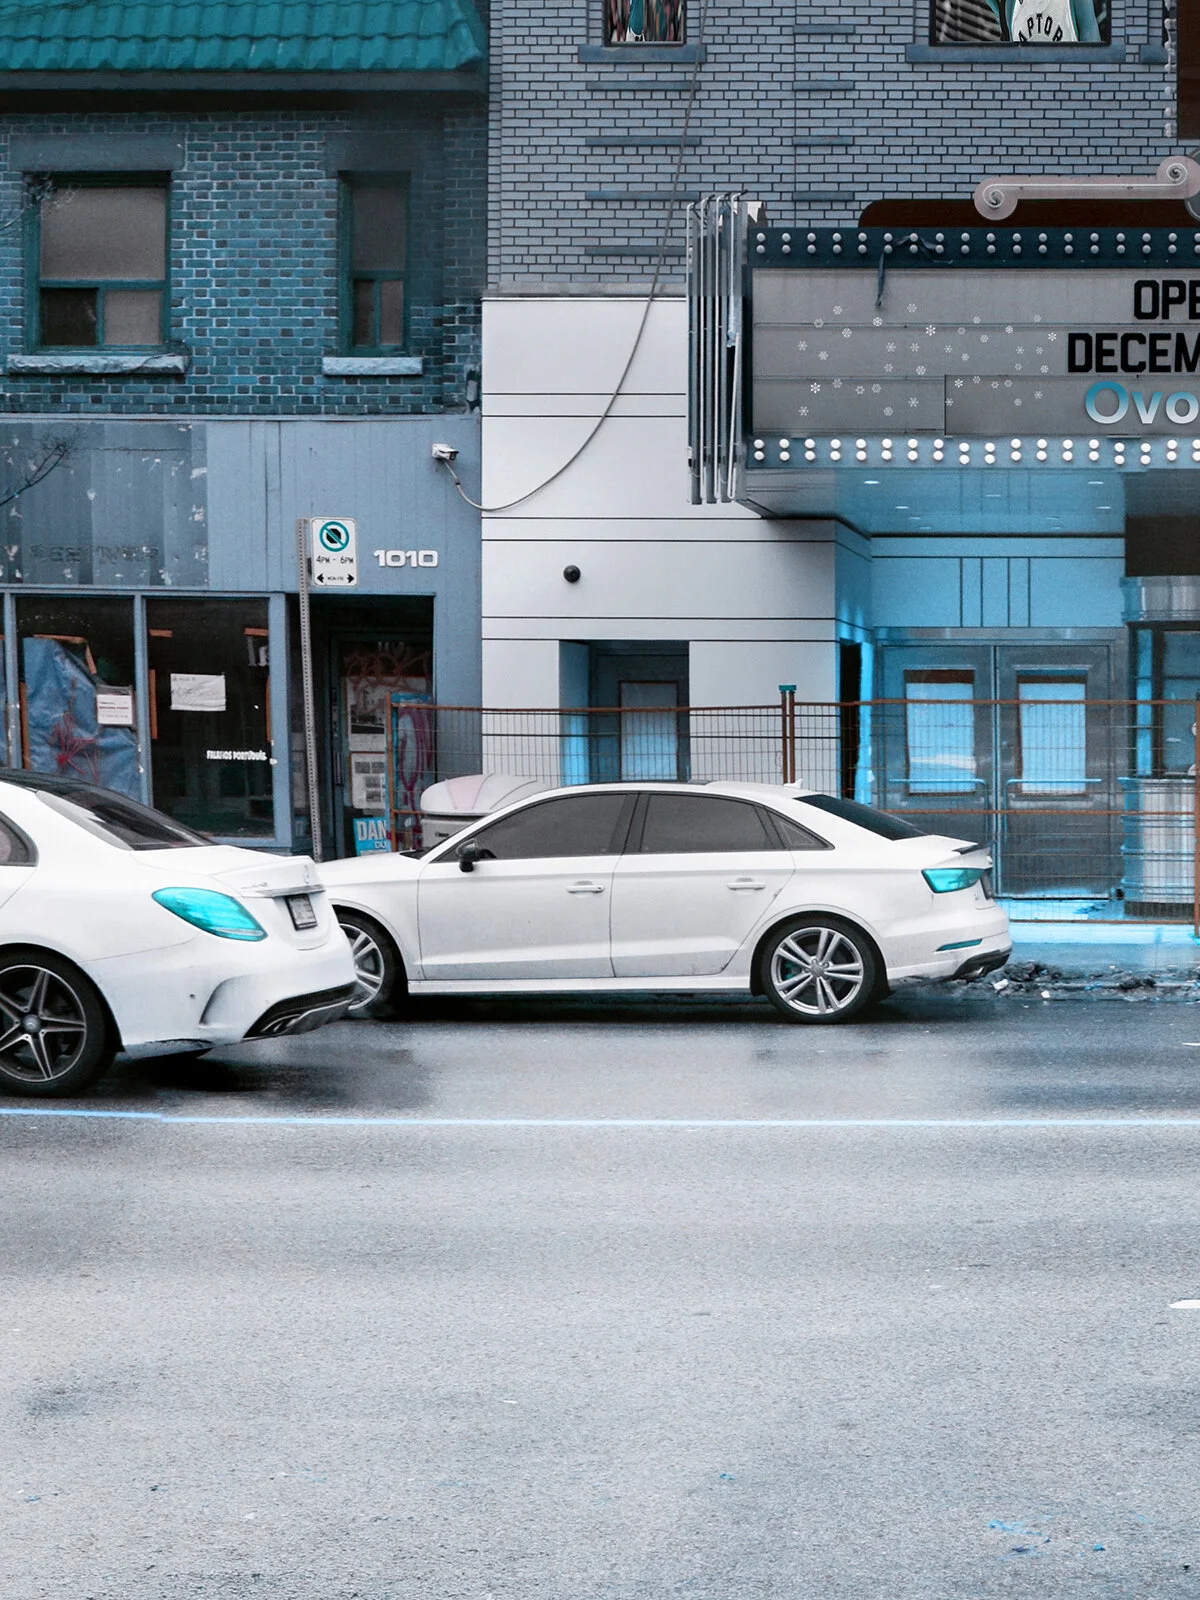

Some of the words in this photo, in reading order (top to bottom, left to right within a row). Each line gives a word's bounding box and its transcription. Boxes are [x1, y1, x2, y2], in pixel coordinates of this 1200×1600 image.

[1085, 381, 1200, 425] Ovo
[316, 555, 330, 564] 4PM
[340, 555, 354, 564] 6PM
[373, 550, 438, 567] 1010
